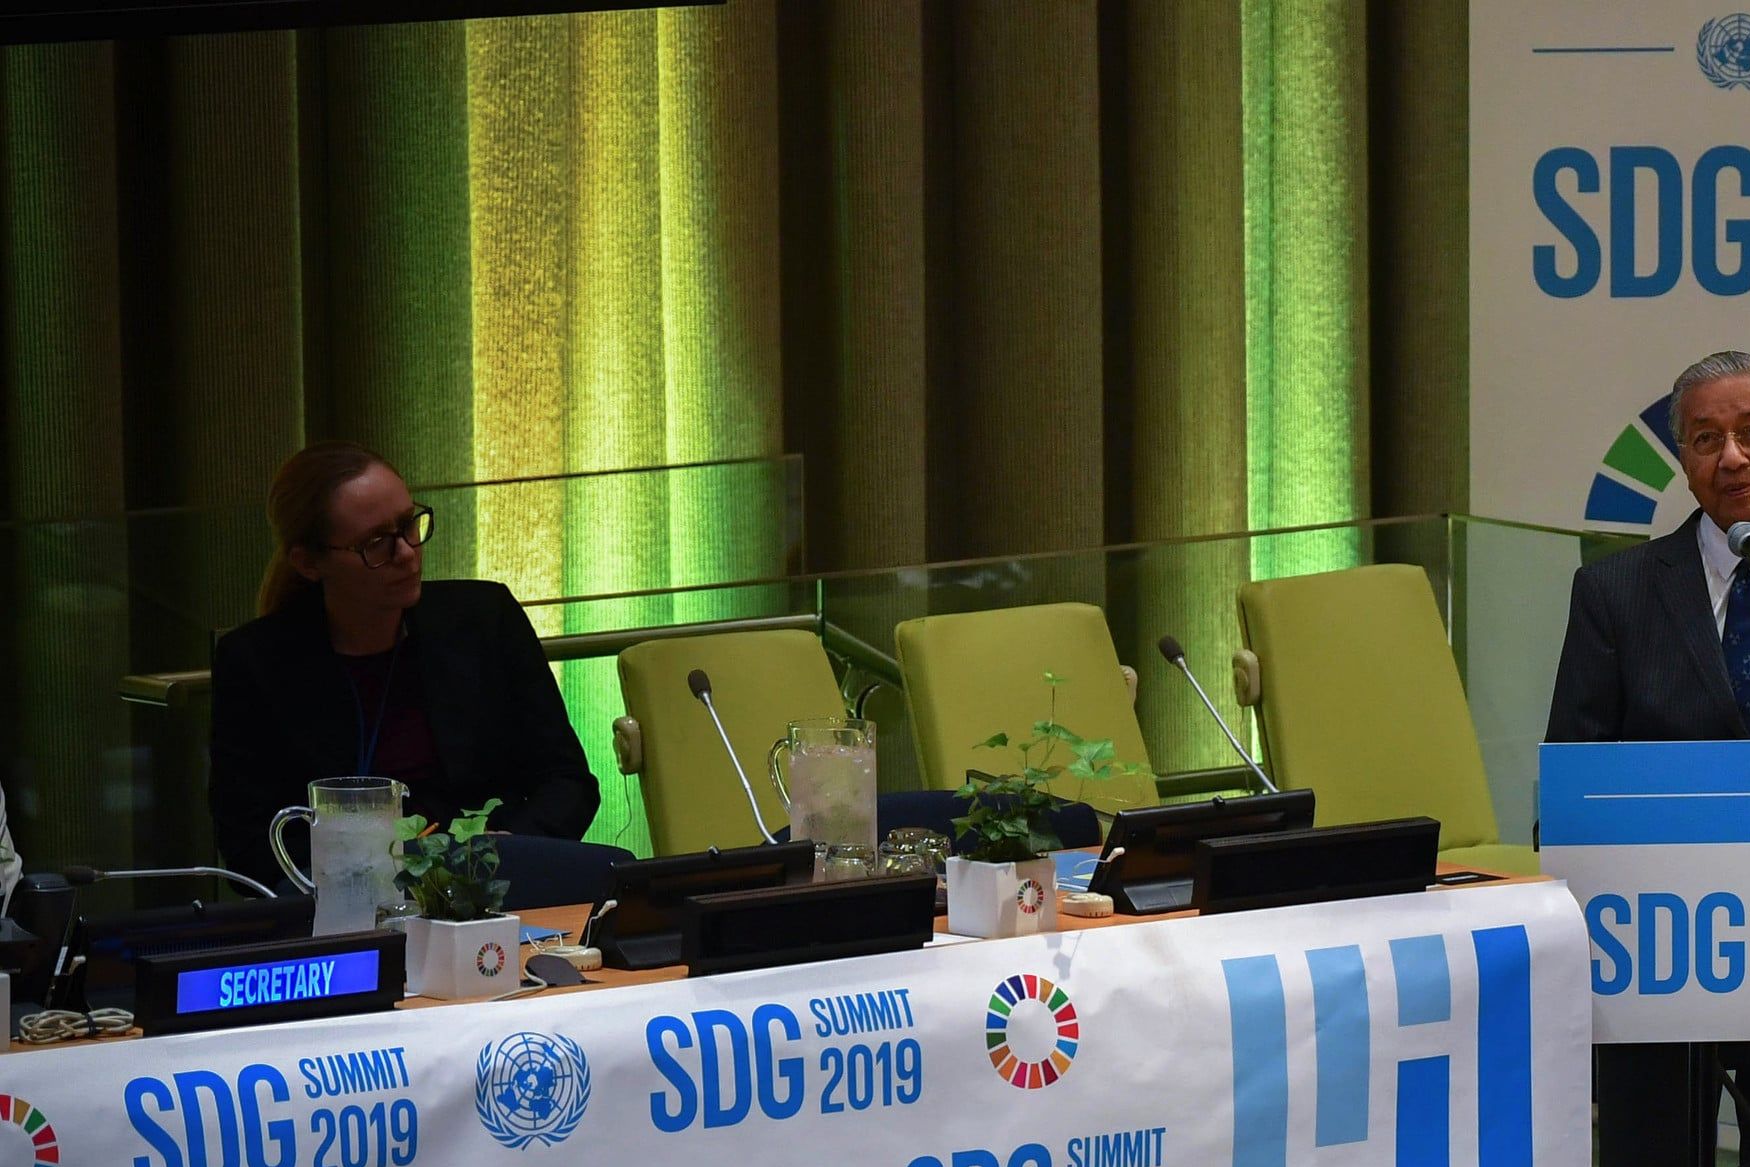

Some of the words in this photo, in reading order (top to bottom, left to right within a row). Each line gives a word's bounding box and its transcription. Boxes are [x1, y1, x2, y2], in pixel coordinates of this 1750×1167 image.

[1585, 891, 1745, 995] SDG
[219, 960, 335, 1008] SECRETARY
[809, 988, 914, 1038] SUMMIT
[299, 1047, 411, 1099] SUMMIT
[646, 1004, 805, 1133] SDG
[820, 1038, 922, 1114] 2019
